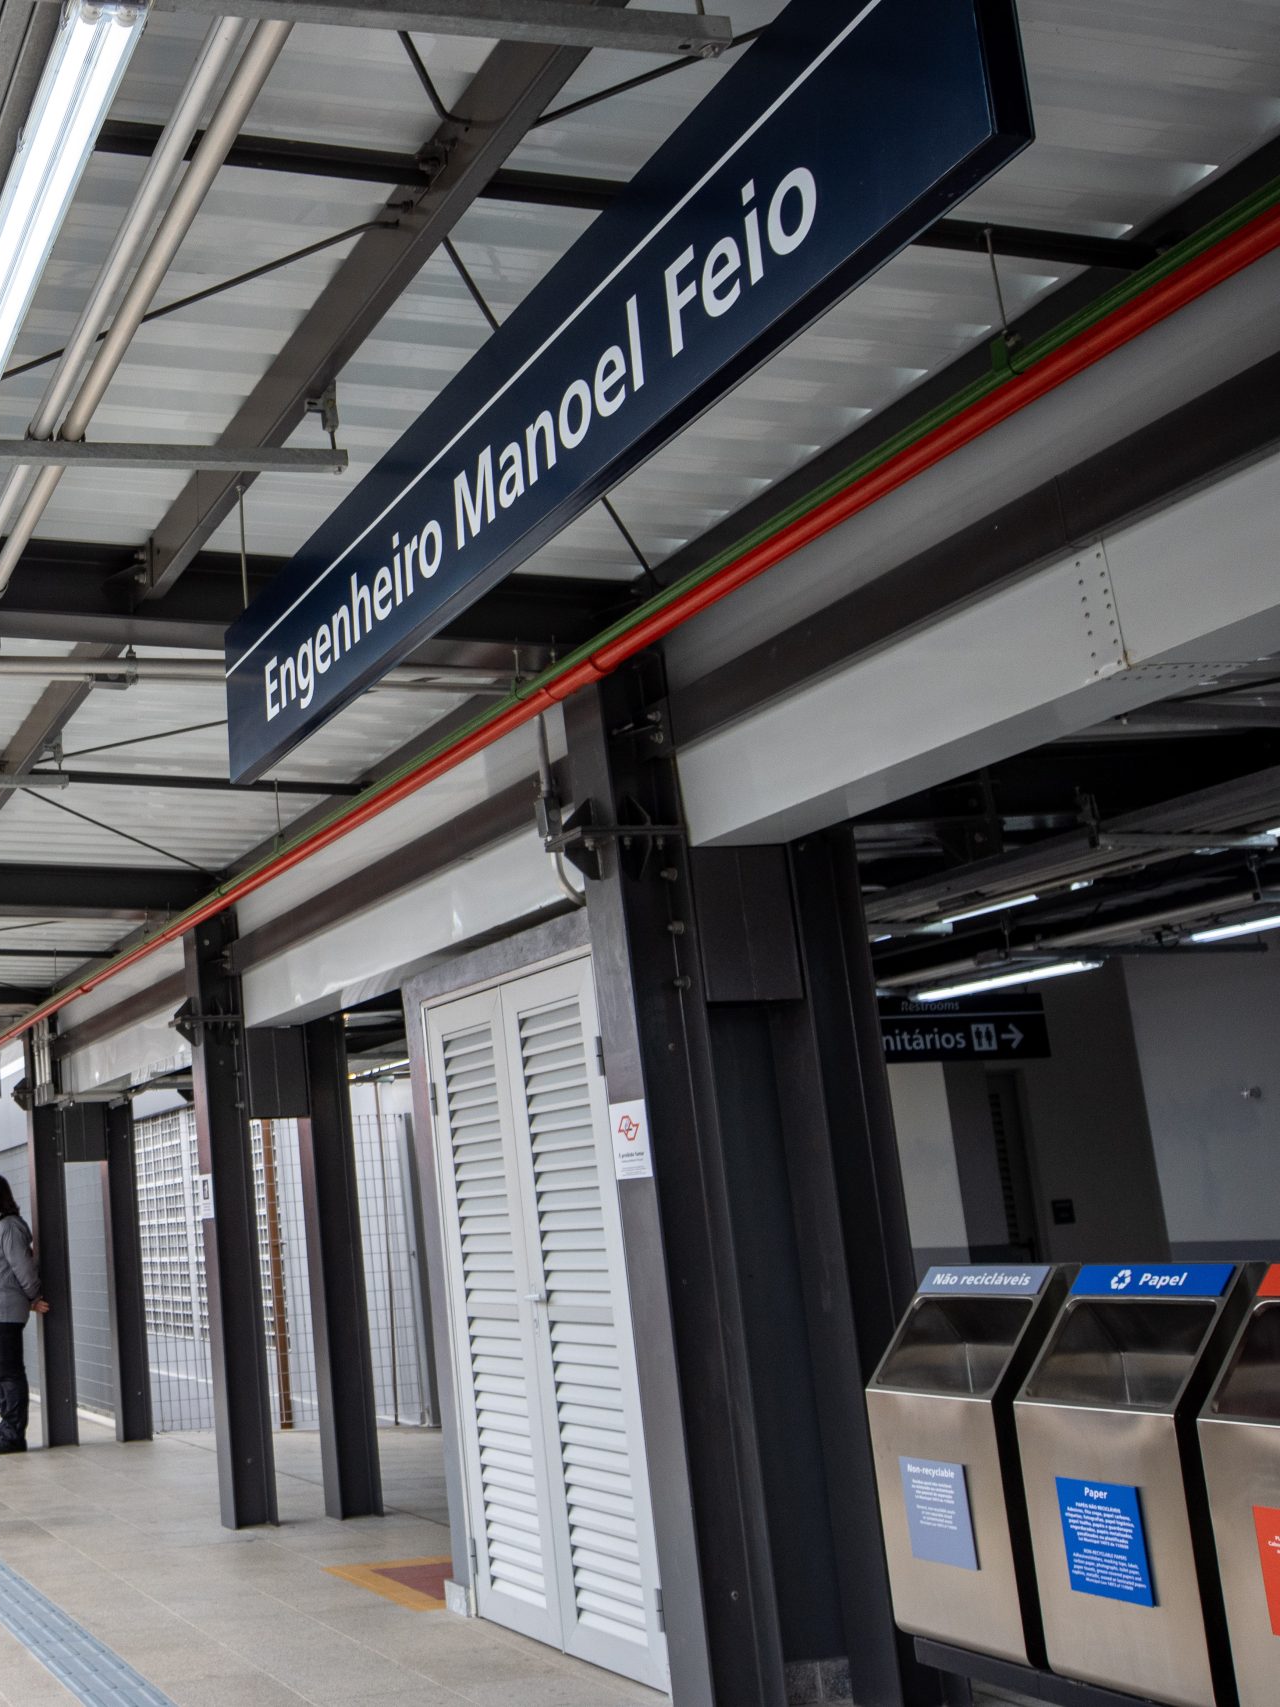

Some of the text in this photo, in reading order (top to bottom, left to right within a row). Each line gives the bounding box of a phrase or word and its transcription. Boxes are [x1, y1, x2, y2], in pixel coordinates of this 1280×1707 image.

[265, 166, 818, 722] Engenheiro Manoel Feio
[932, 1271, 1031, 1286] Não recicláveis
[1138, 1272, 1188, 1290] Papel
[907, 1464, 955, 1478] Non-recyclable
[1084, 1487, 1108, 1500] Paper
